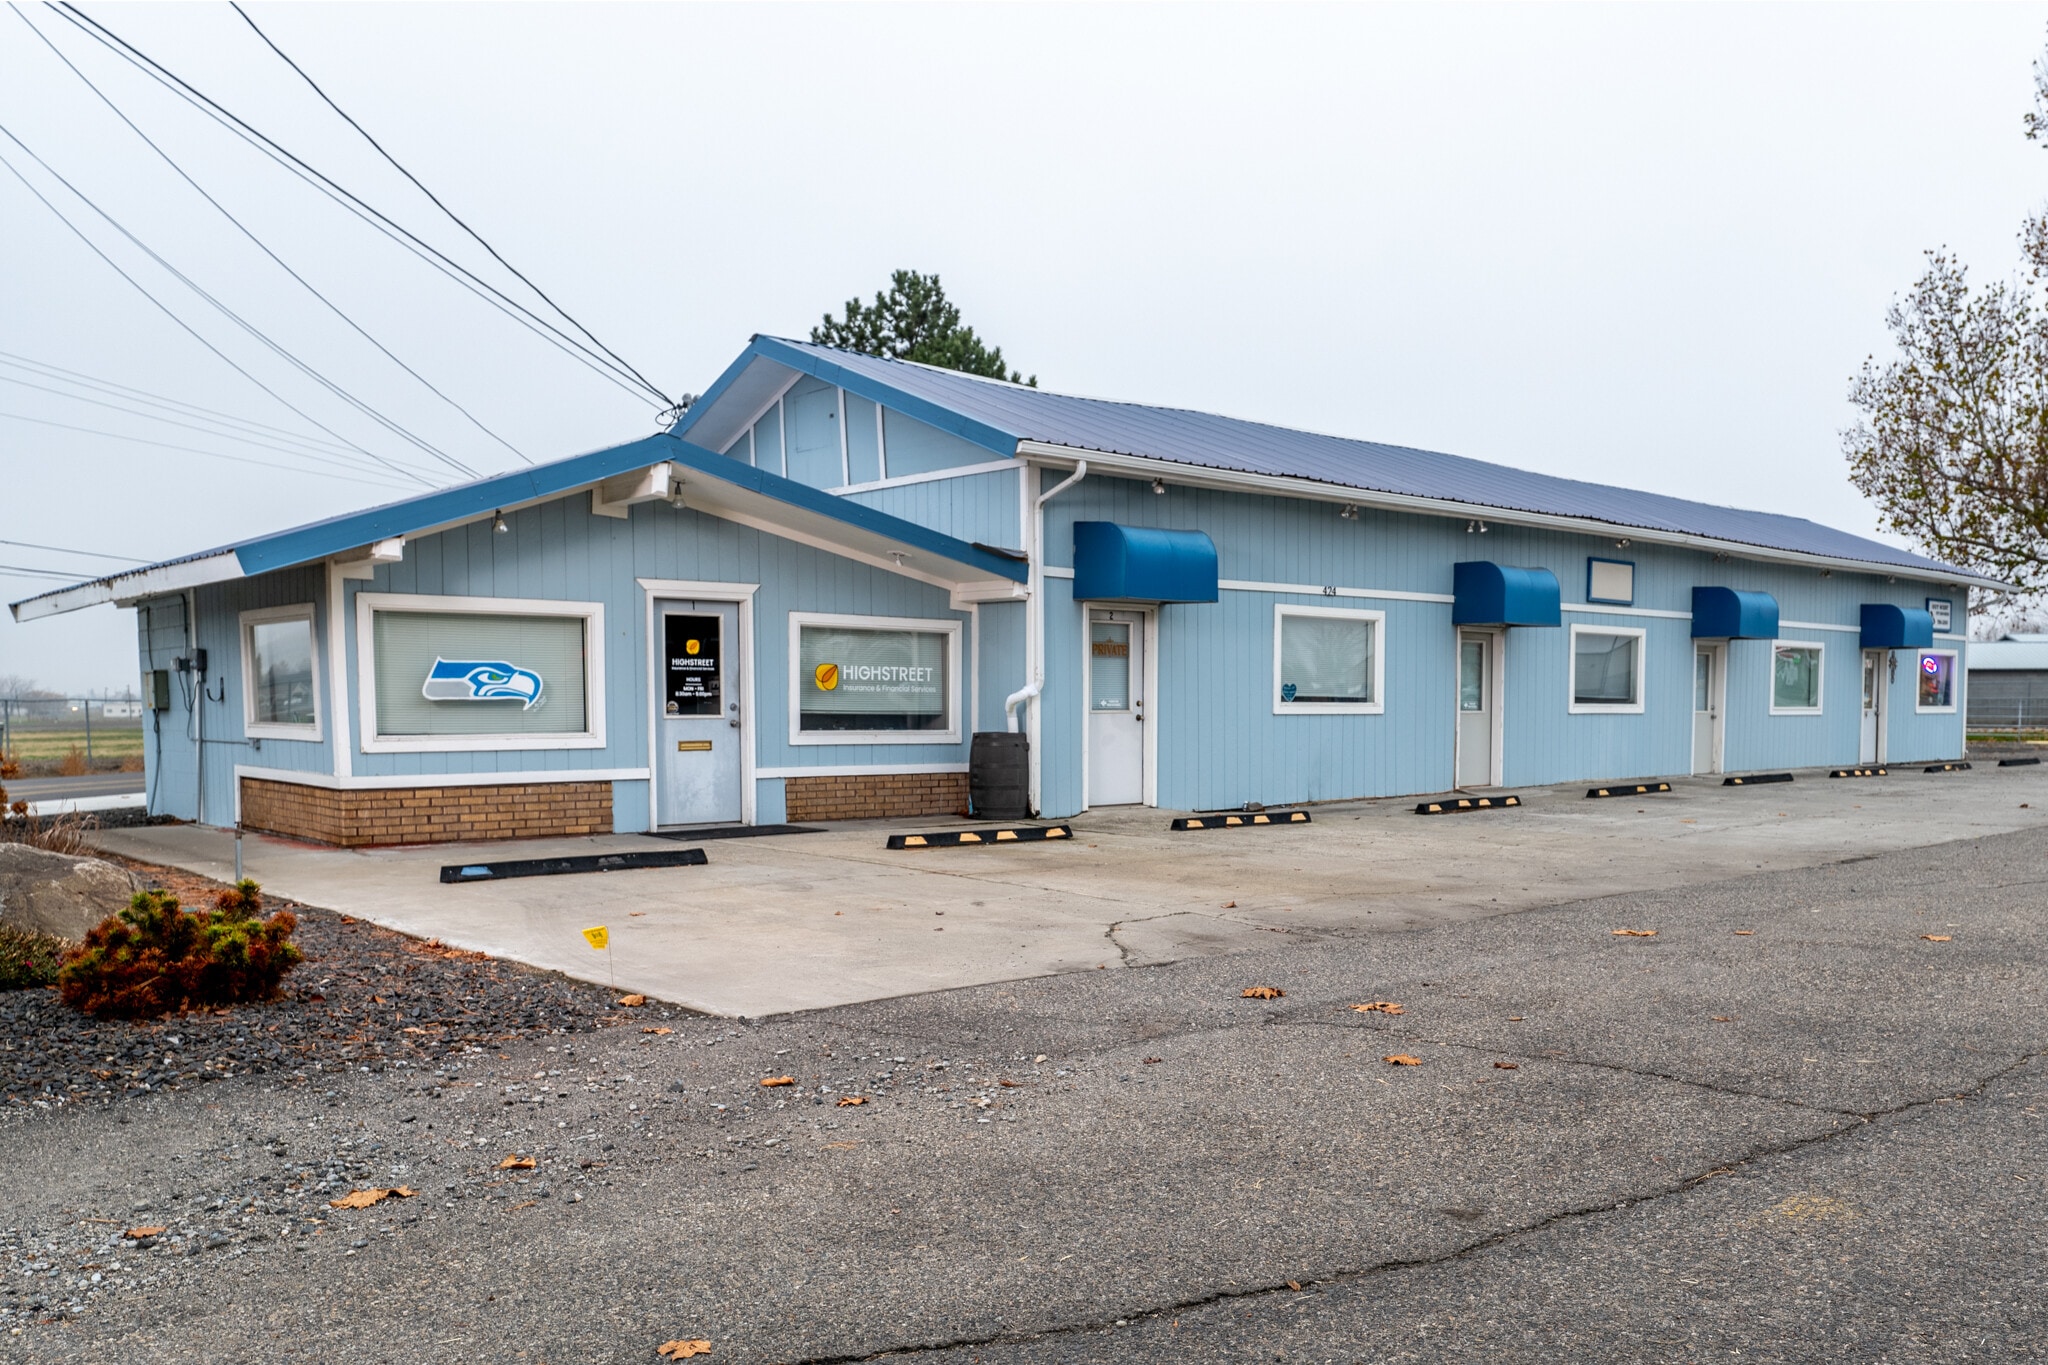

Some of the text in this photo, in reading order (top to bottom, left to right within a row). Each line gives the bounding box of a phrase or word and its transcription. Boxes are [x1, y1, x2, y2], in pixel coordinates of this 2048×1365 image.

[1323, 586, 1337, 596] 424
[1109, 611, 1114, 620] 2
[1092, 643, 1128, 656] PRIVATE
[671, 658, 714, 667] HIGHSTREET
[843, 665, 933, 682] HIGHSTREET
[843, 684, 937, 693] Insurance & Financial Services
